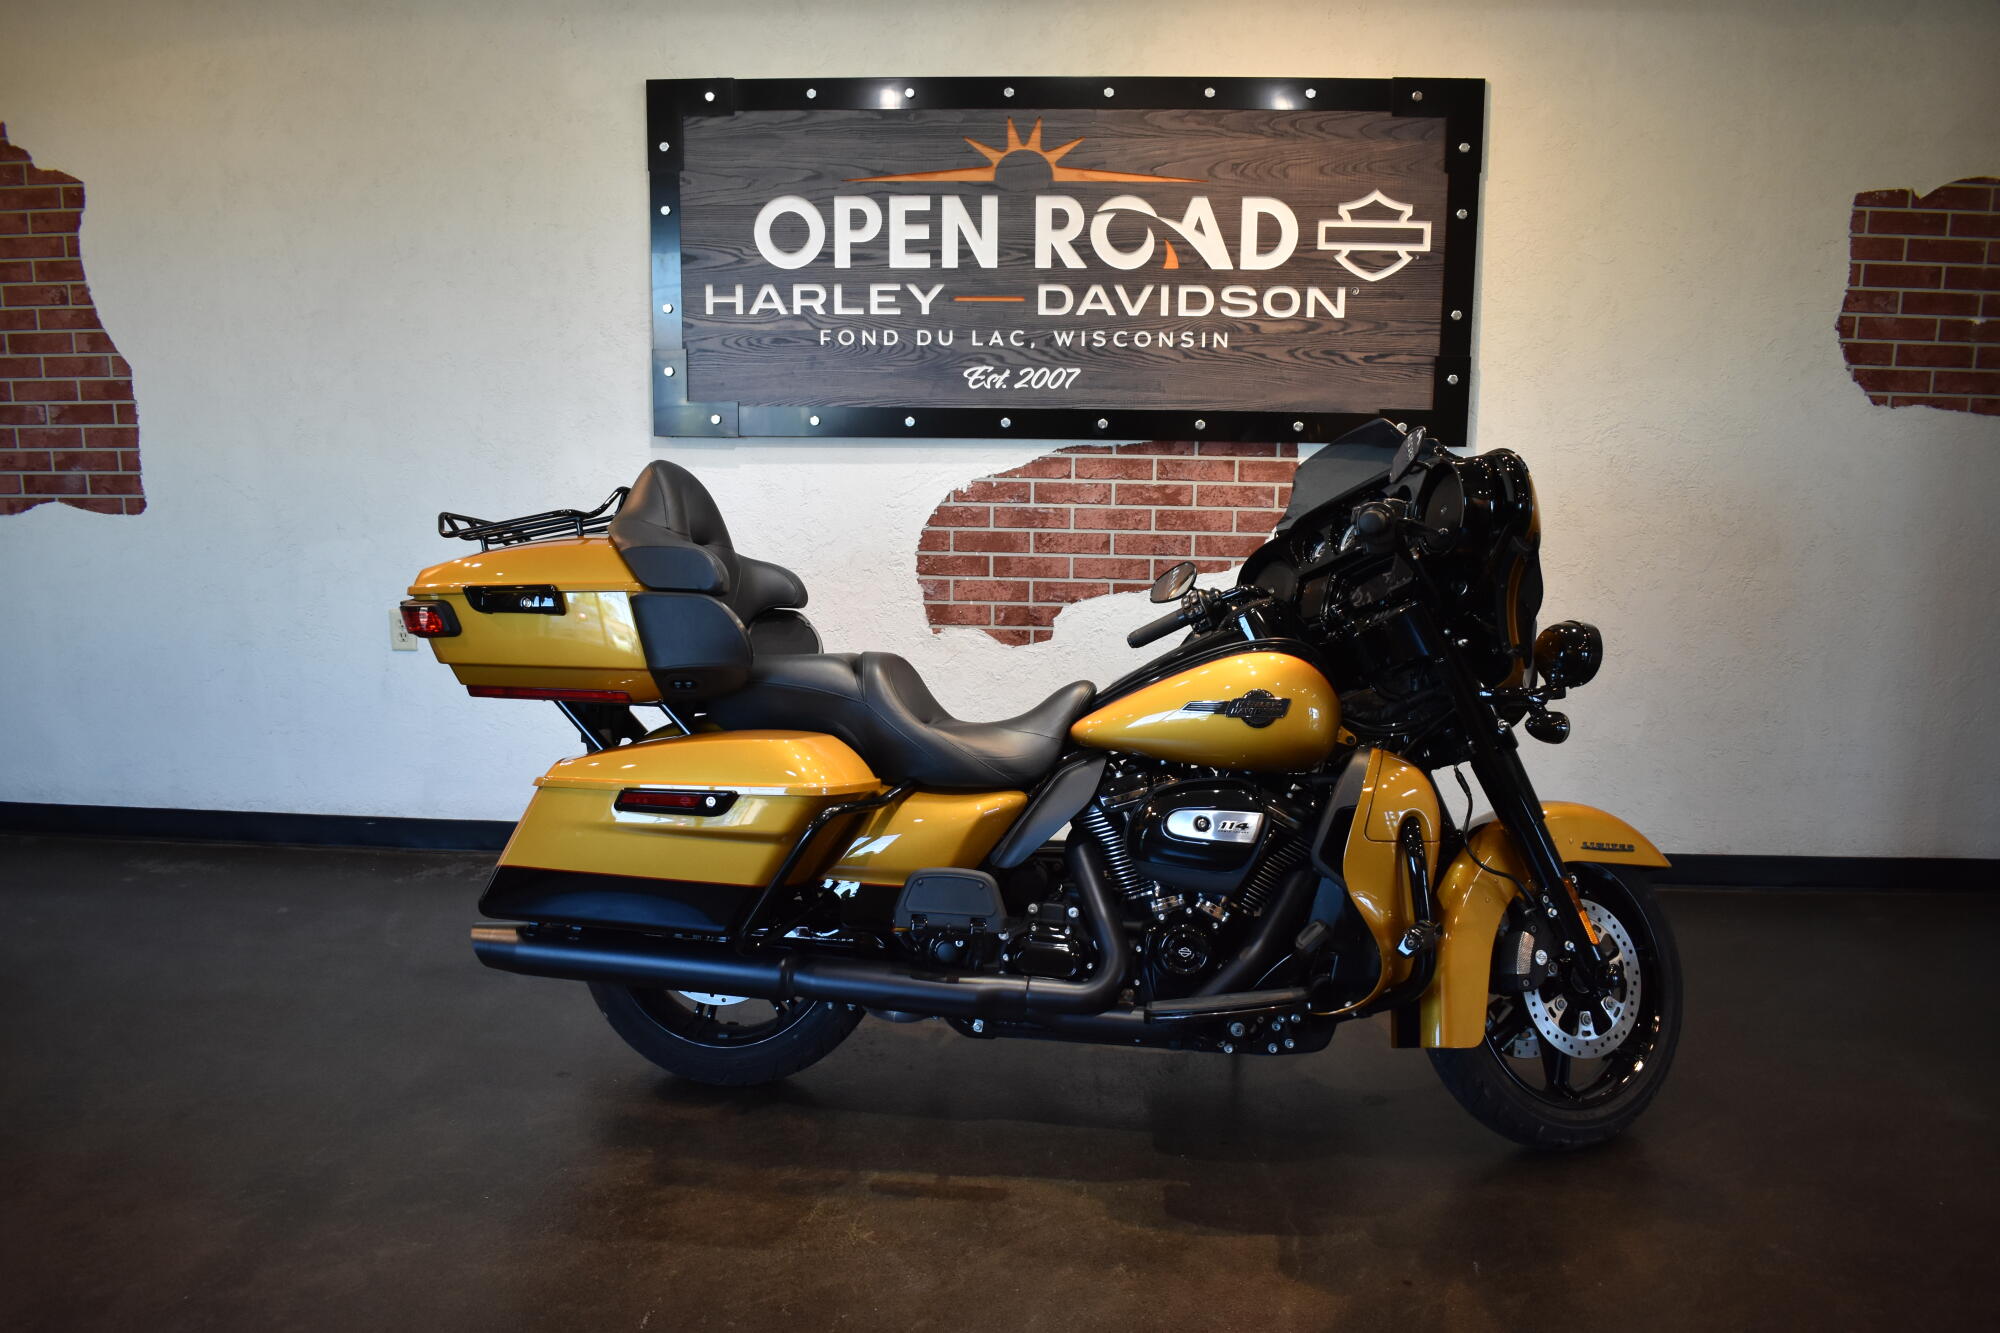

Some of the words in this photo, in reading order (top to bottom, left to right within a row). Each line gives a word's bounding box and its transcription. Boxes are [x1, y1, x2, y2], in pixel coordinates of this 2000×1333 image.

[754, 195, 998, 270] OPEN
[1035, 195, 1298, 271] ROAD
[705, 283, 945, 315] HARLEY
[1038, 284, 1346, 318] DAVIDSON
[820, 329, 899, 346] FOND
[916, 330, 954, 347] DU
[971, 330, 1036, 349] LAC,
[1053, 330, 1229, 348] WISCONSIN
[963, 365, 1010, 390] Est.
[1013, 367, 1082, 390] 2007
[1220, 821, 1249, 830] 114
